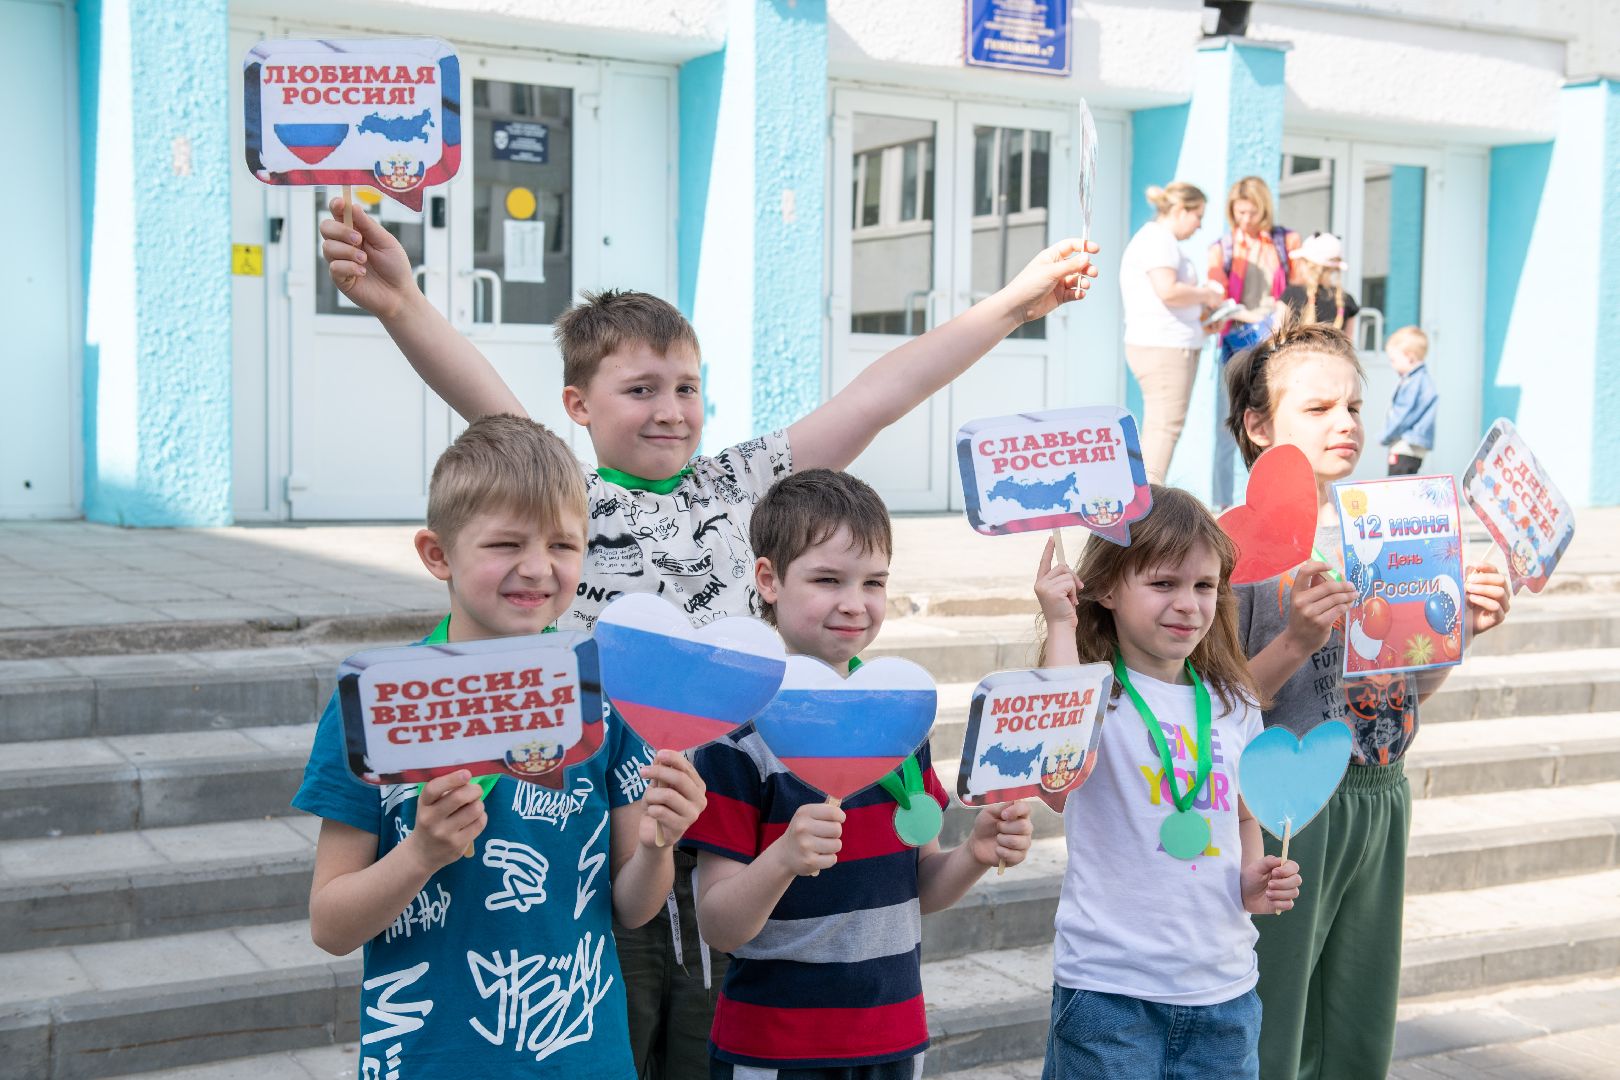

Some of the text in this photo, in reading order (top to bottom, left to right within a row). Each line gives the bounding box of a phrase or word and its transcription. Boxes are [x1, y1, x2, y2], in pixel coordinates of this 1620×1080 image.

[263, 65, 436, 85] ЛЮБИМАЯ
[282, 86, 416, 105] РОССИЯ!
[978, 427, 1121, 457] СЛАВЬСЯ,
[991, 446, 1116, 474] РОССИЯ!
[1492, 453, 1556, 543] РОССИИ!
[1353, 514, 1383, 540] 12
[1387, 551, 1424, 570] День
[1371, 577, 1441, 600] России
[373, 668, 543, 702] РОССИЯ
[370, 685, 575, 725] ВЕЛИКАЯ
[991, 688, 1095, 716] МОГУЧАЯ
[387, 708, 565, 745] СТРАНА!
[994, 709, 1085, 734] РОССИЯ!
[1139, 765, 1231, 812] YOUR
